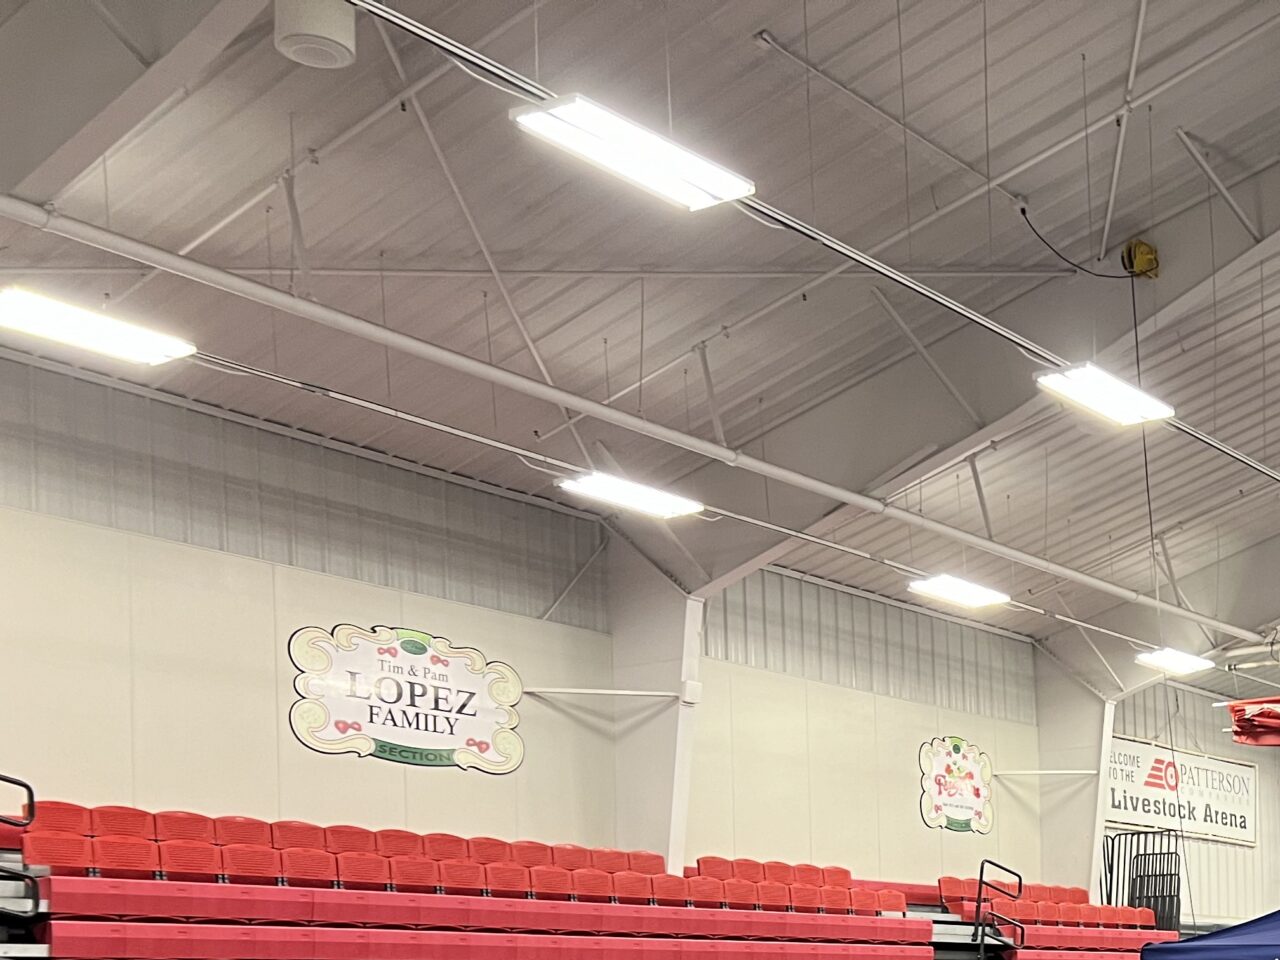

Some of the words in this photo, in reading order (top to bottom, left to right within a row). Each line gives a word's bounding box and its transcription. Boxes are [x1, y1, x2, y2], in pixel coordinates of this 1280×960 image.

[378, 659, 404, 675] Tim
[407, 665, 419, 677] &
[422, 667, 449, 683] Pam
[345, 670, 478, 717] LOPEZ
[367, 704, 460, 736] FAMILY
[378, 744, 452, 762] SECTION
[1109, 752, 1141, 768] ELCOME
[1120, 768, 1136, 783] THE
[1180, 763, 1251, 796] PATTERSON
[1110, 787, 1197, 821] Livestock
[1203, 803, 1247, 830] Arena
